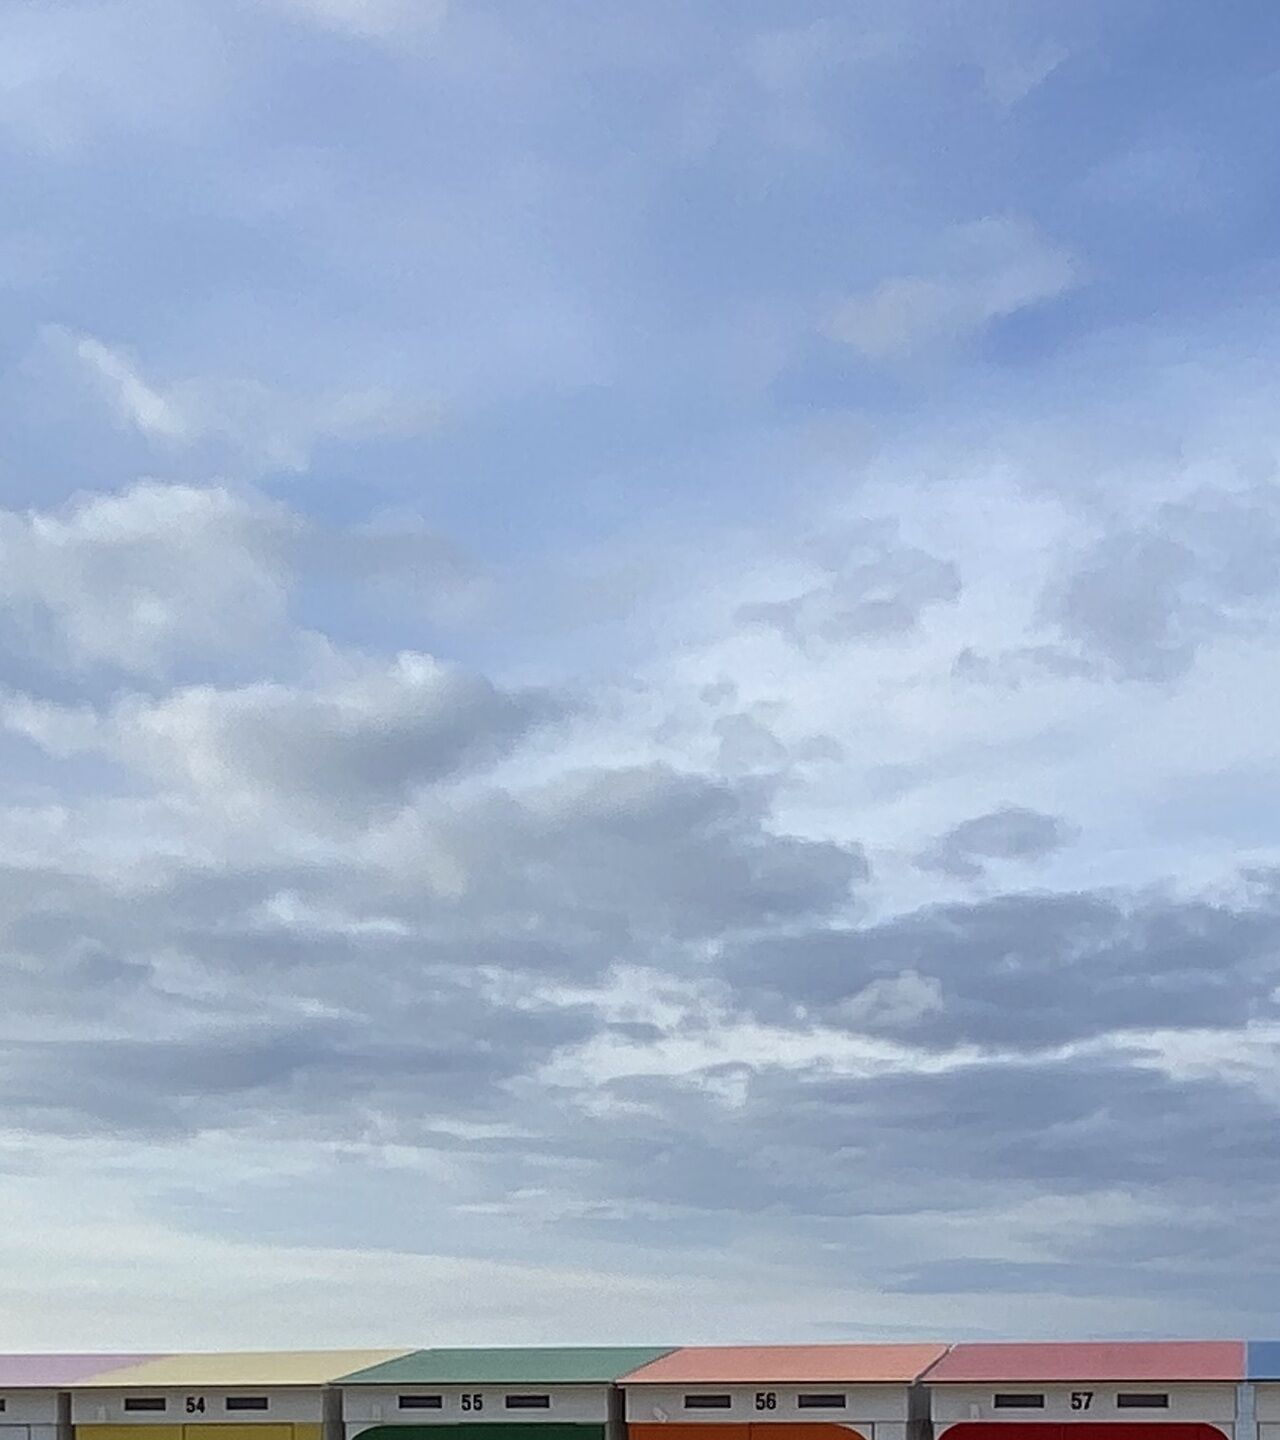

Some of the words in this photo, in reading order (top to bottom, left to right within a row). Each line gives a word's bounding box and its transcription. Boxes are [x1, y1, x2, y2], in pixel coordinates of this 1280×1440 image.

[186, 1397, 206, 1414] 54
[462, 1393, 482, 1411] 55
[755, 1392, 777, 1411] 56
[1071, 1391, 1094, 1410] 57
